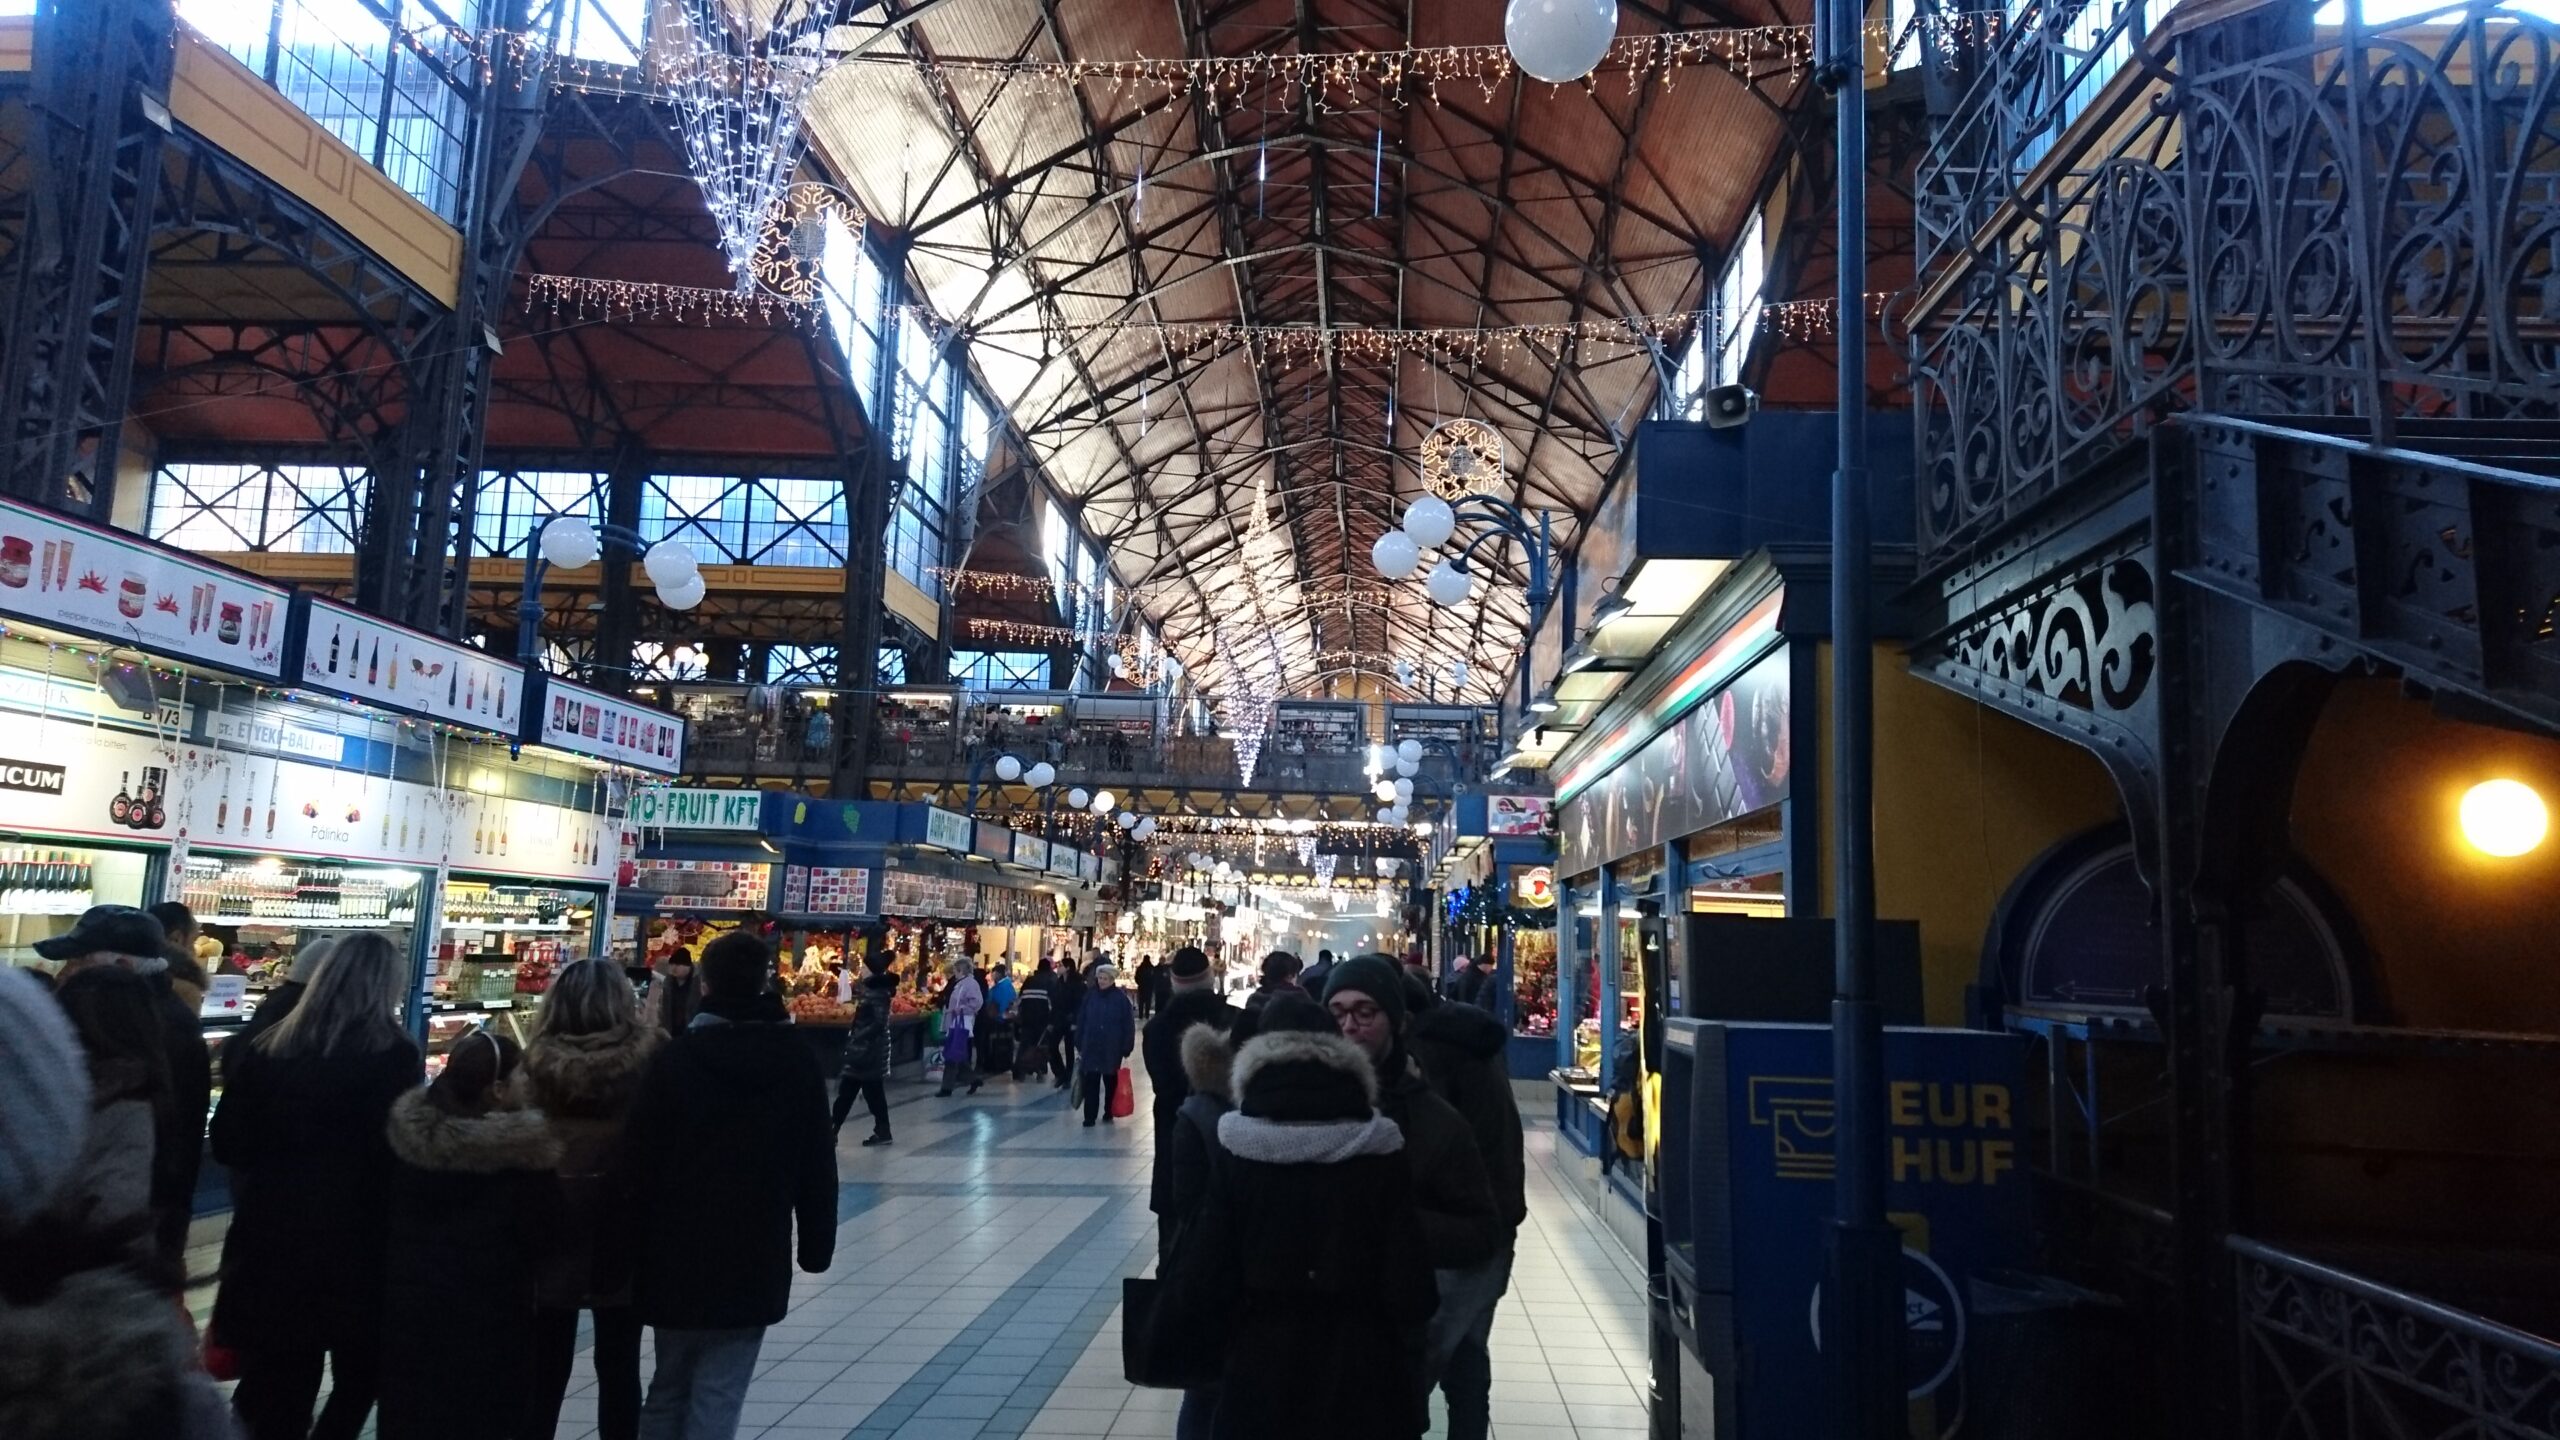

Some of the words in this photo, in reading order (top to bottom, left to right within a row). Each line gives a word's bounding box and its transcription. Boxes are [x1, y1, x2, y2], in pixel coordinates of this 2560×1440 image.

[57, 608, 89, 624] pepper
[90, 616, 117, 630] cream
[722, 795, 760, 826] KFT.
[1890, 1081, 2012, 1129] EUR
[1891, 1136, 2015, 1185] HUF
